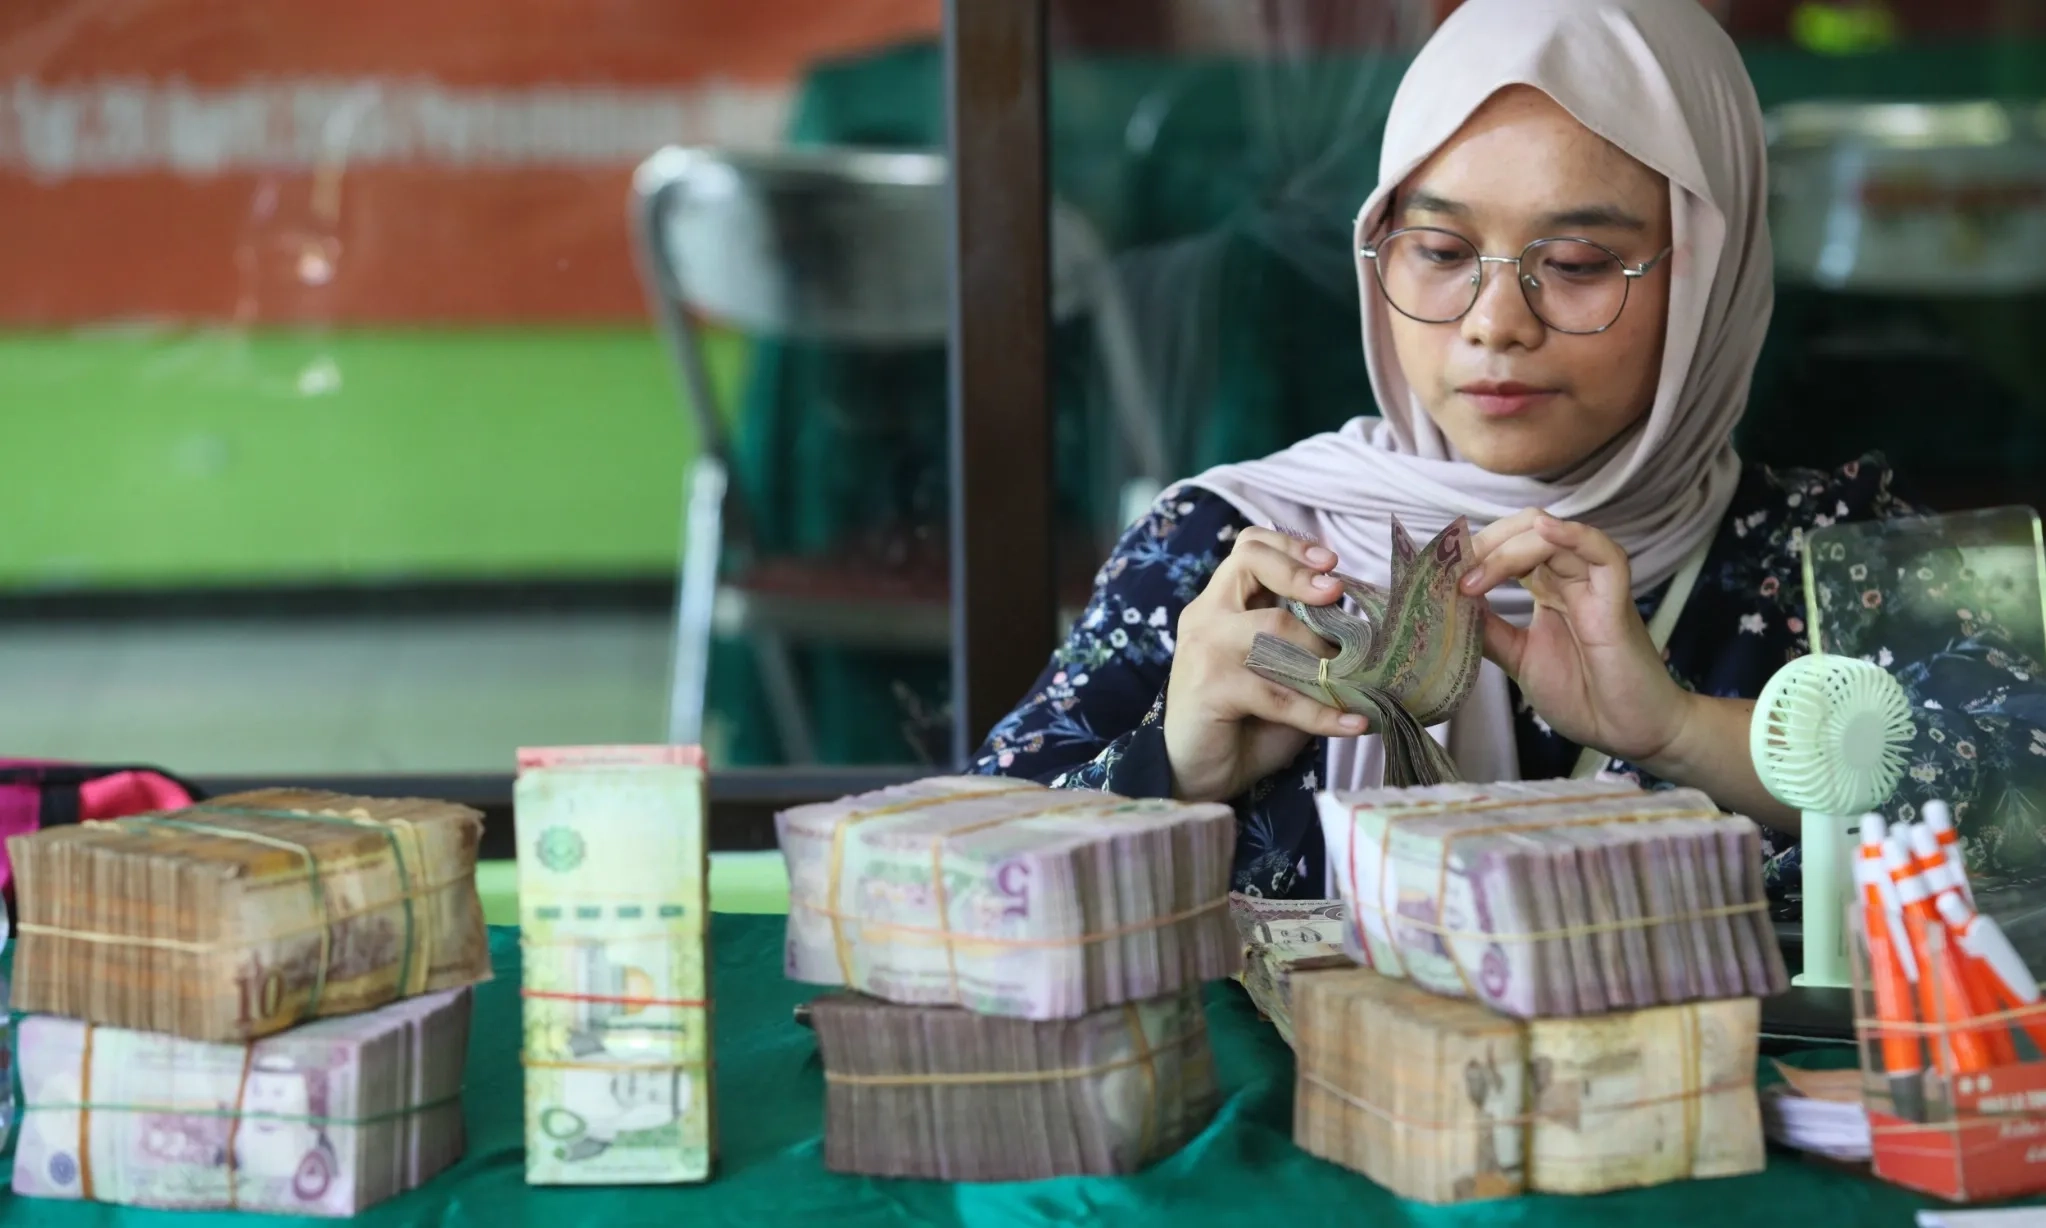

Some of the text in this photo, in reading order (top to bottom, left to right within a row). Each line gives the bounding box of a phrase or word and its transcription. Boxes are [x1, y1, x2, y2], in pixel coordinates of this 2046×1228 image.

[1437, 527, 1462, 577] 5
[998, 861, 1029, 917] 5
[233, 967, 285, 1027] 10
